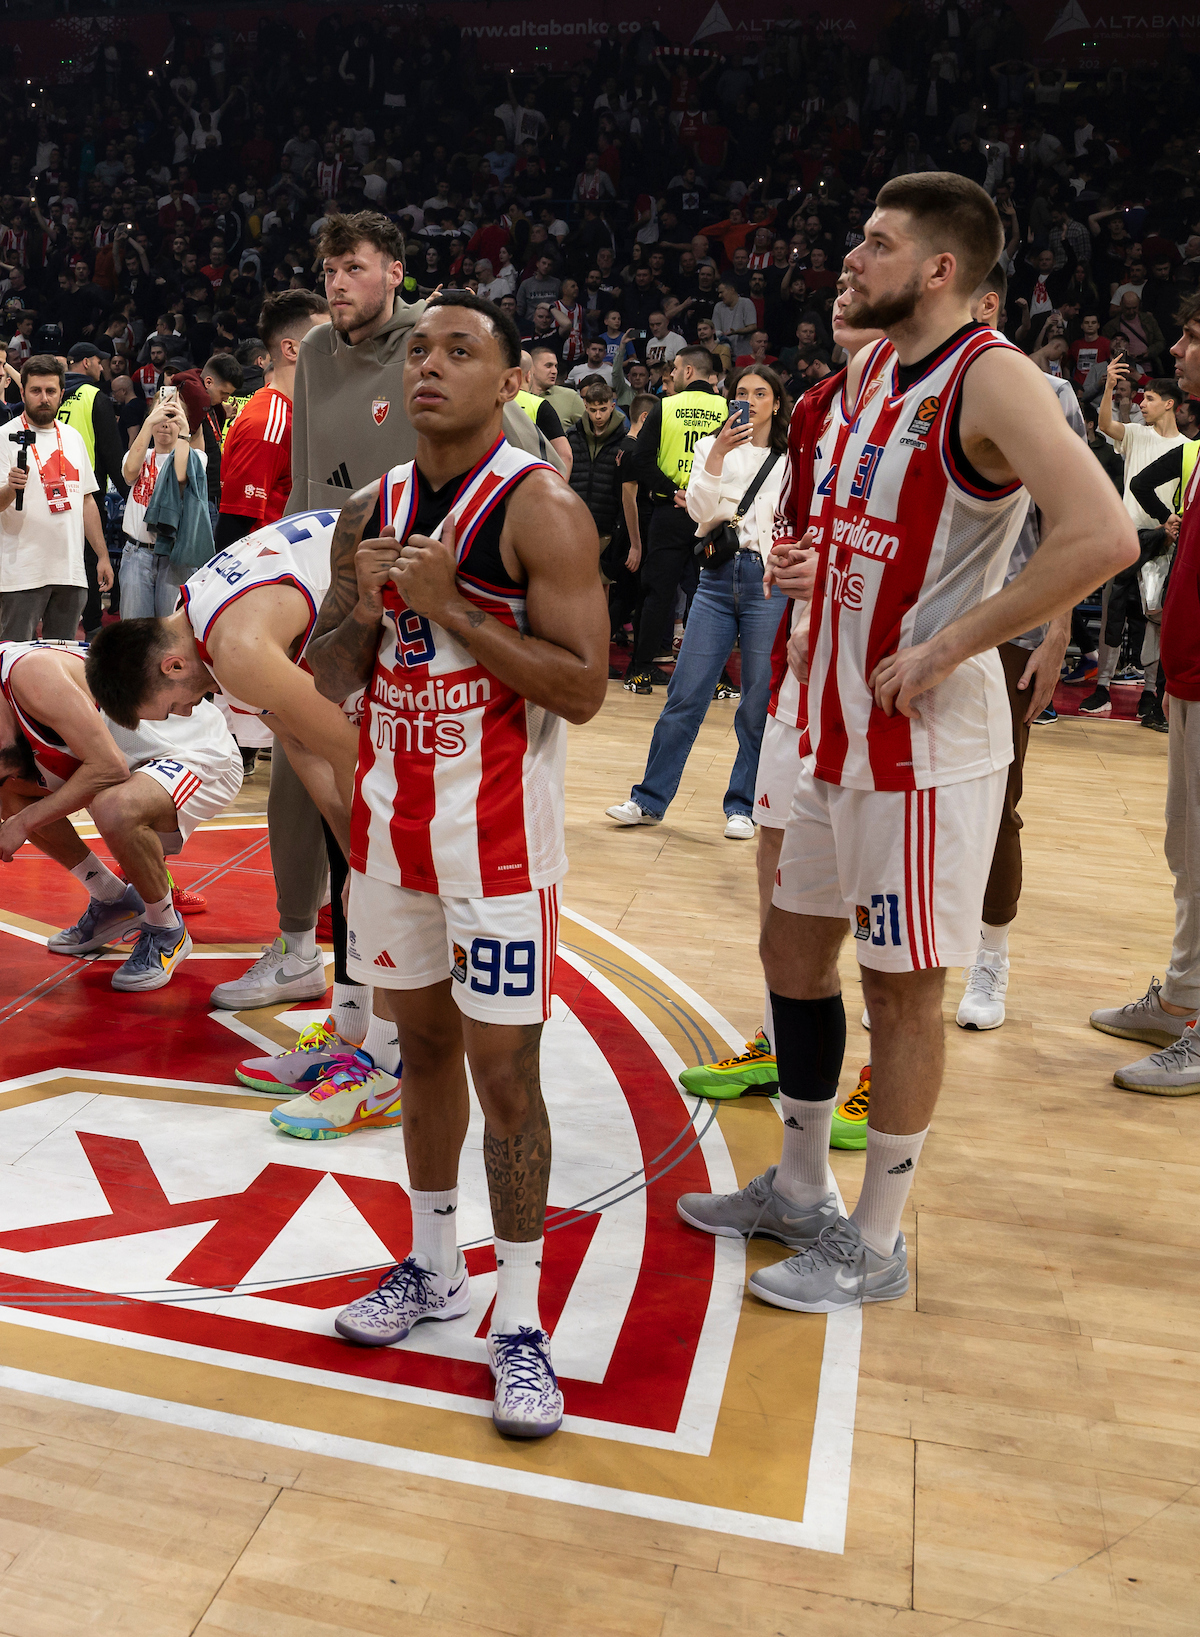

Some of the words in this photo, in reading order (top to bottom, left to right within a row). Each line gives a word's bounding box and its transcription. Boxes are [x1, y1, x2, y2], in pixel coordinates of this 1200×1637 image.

[1094, 15, 1200, 29] ALTABAN
[683, 420, 712, 428] SECURITY
[851, 443, 885, 500] 31
[374, 677, 491, 712] meridian
[376, 711, 467, 758] mts
[497, 863, 523, 871] AEROREADY
[871, 894, 902, 946] 31
[470, 937, 536, 996] 99
